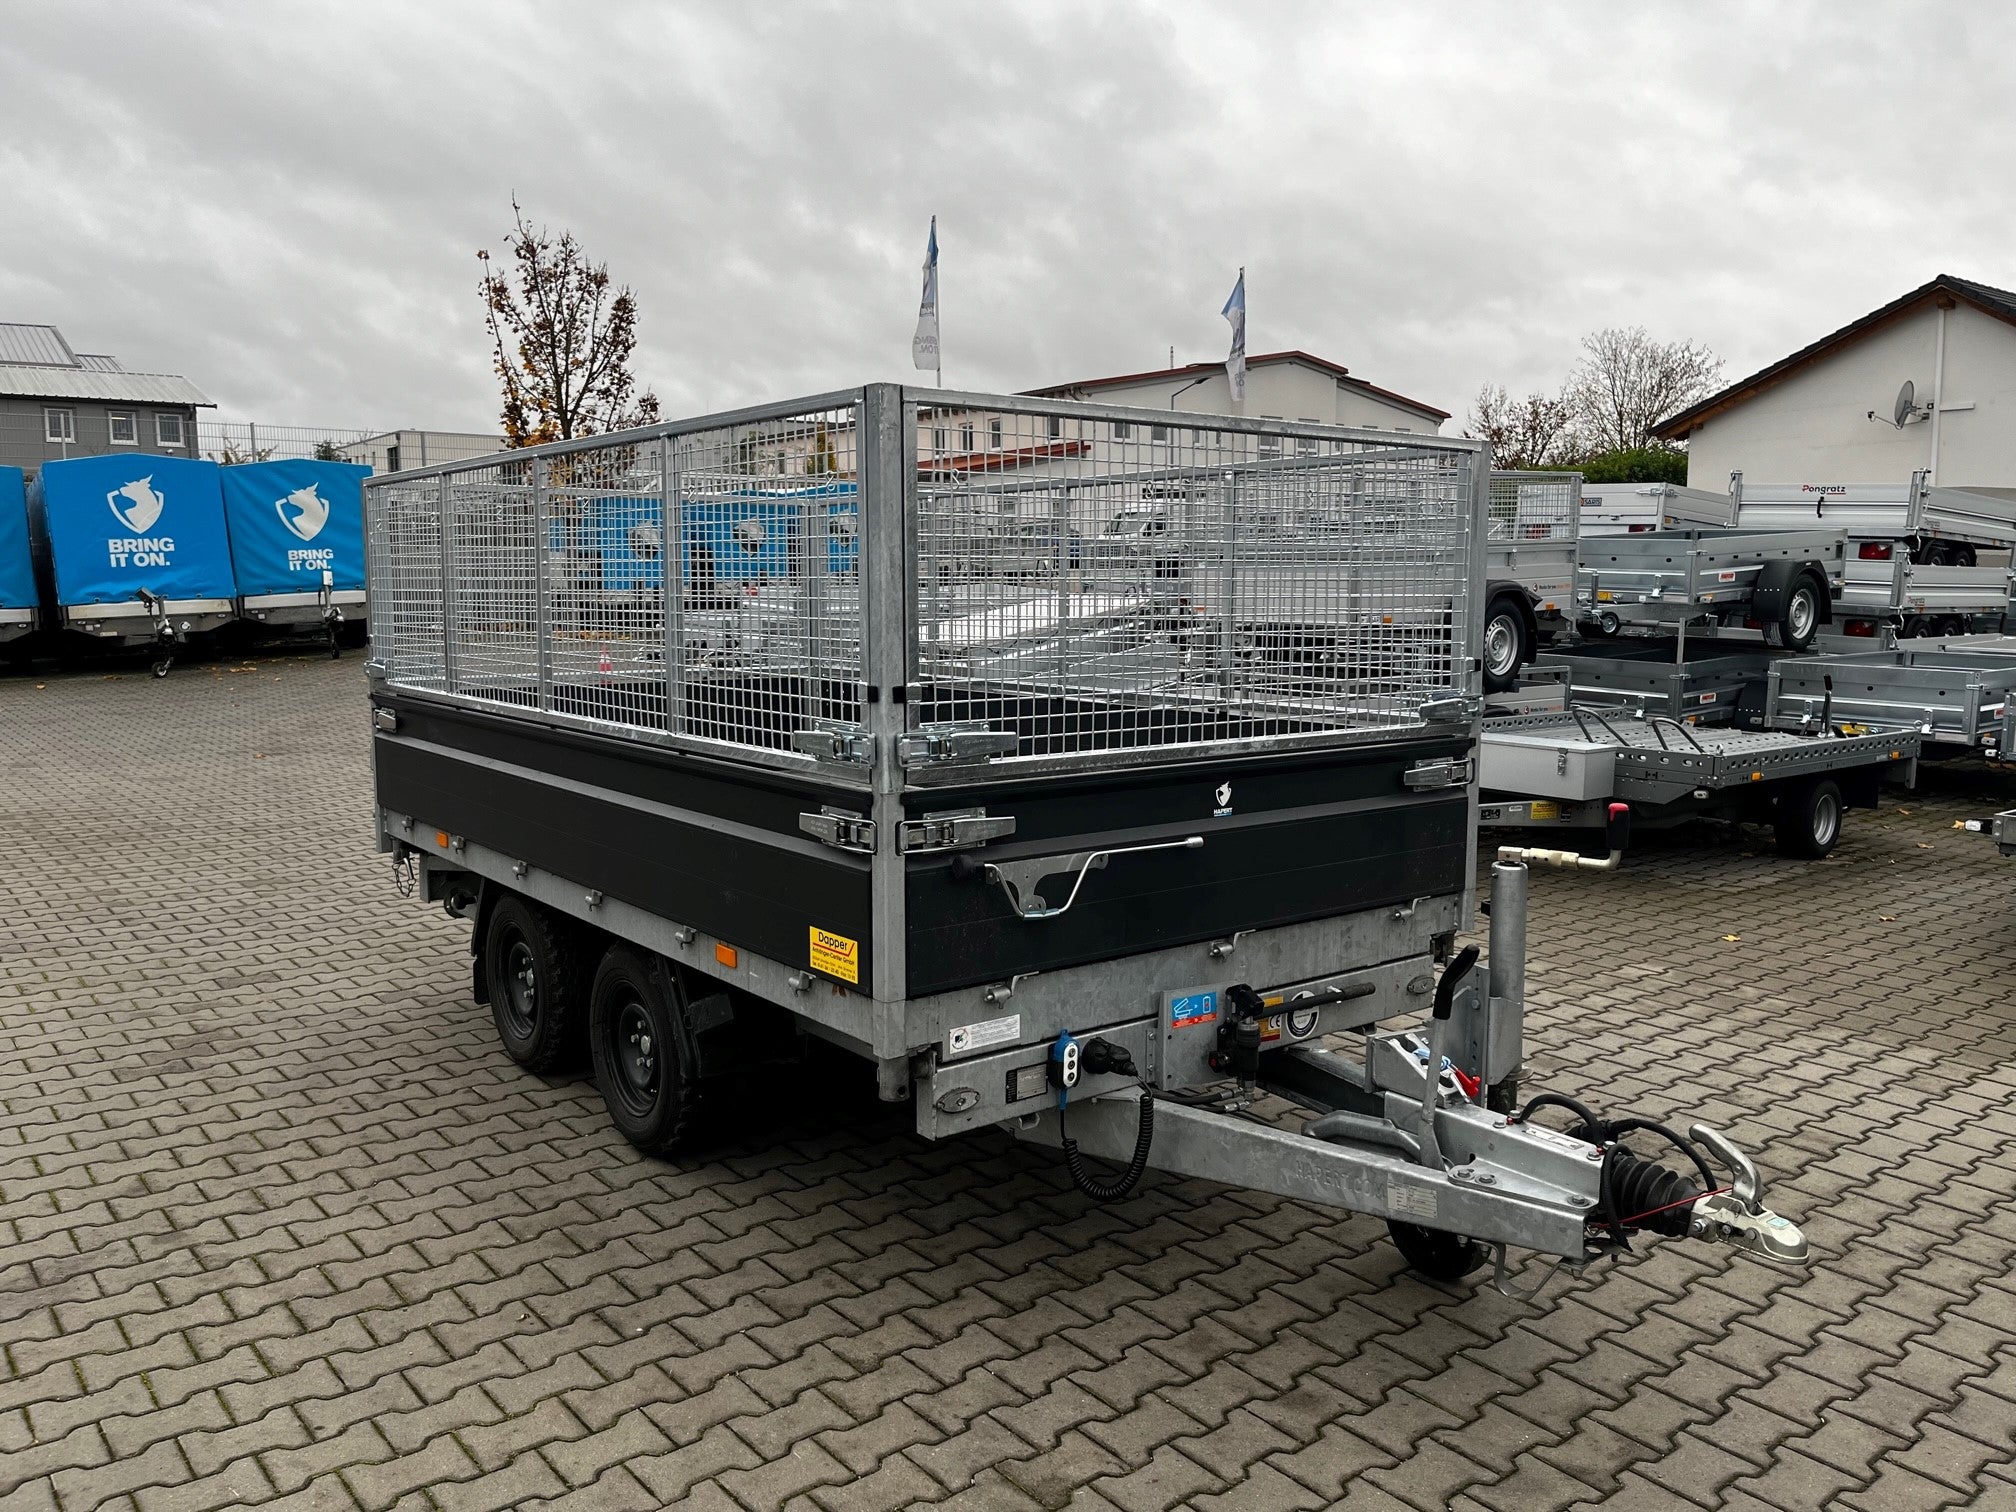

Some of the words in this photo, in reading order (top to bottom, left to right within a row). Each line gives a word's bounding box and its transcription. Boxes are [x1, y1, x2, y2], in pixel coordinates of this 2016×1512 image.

[1802, 484, 1846, 494] Pongratz
[108, 538, 175, 553] BRING
[110, 553, 128, 567] IT
[133, 553, 171, 567] ON.
[288, 549, 334, 560] BRING
[290, 561, 302, 570] IT
[306, 560, 331, 570] ON.
[818, 931, 847, 950] Dapper
